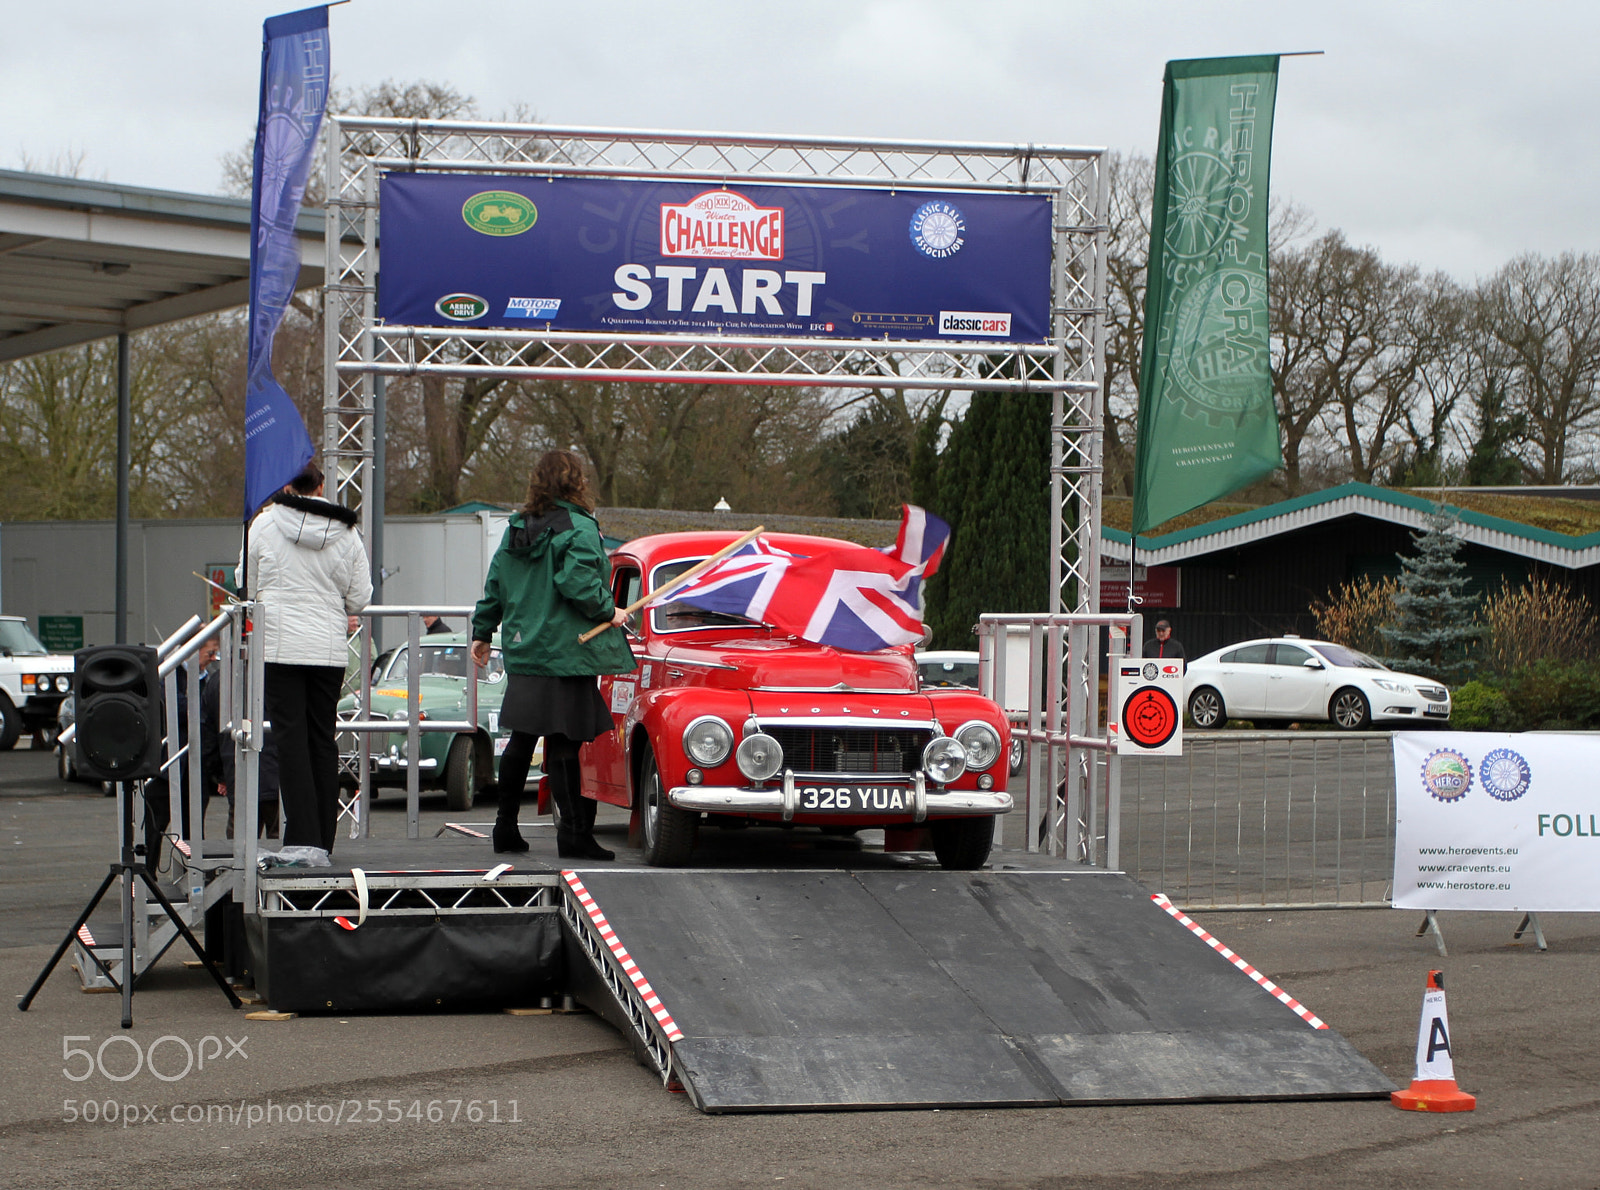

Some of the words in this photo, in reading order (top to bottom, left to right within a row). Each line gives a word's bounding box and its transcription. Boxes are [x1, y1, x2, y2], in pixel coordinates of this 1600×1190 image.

[715, 197, 729, 206] XIX
[731, 200, 751, 211] 2014
[705, 211, 736, 221] Winter
[913, 204, 941, 232] CLASSIC
[943, 205, 966, 232] RALLY
[665, 209, 779, 257] CHALLENGE
[915, 235, 965, 258] ASSOCIATION
[612, 263, 826, 317] START
[510, 299, 559, 309] MOTORS
[525, 308, 541, 317] TV
[852, 313, 935, 326] ORIANDA
[809, 323, 825, 331] EFG
[780, 706, 910, 716] VOLVO
[1483, 751, 1505, 776] CLASSIC
[1507, 752, 1528, 775] RALLY
[1435, 776, 1463, 787] HERO
[1485, 780, 1528, 799] ASSOCIATION
[803, 787, 851, 809] 326
[857, 788, 904, 809] YUA
[1419, 846, 1519, 856] www.heroevents.eu
[1418, 864, 1511, 873] www.craevents.eu
[1417, 880, 1511, 891] www.herostore.eu
[1426, 1017, 1452, 1063] A
